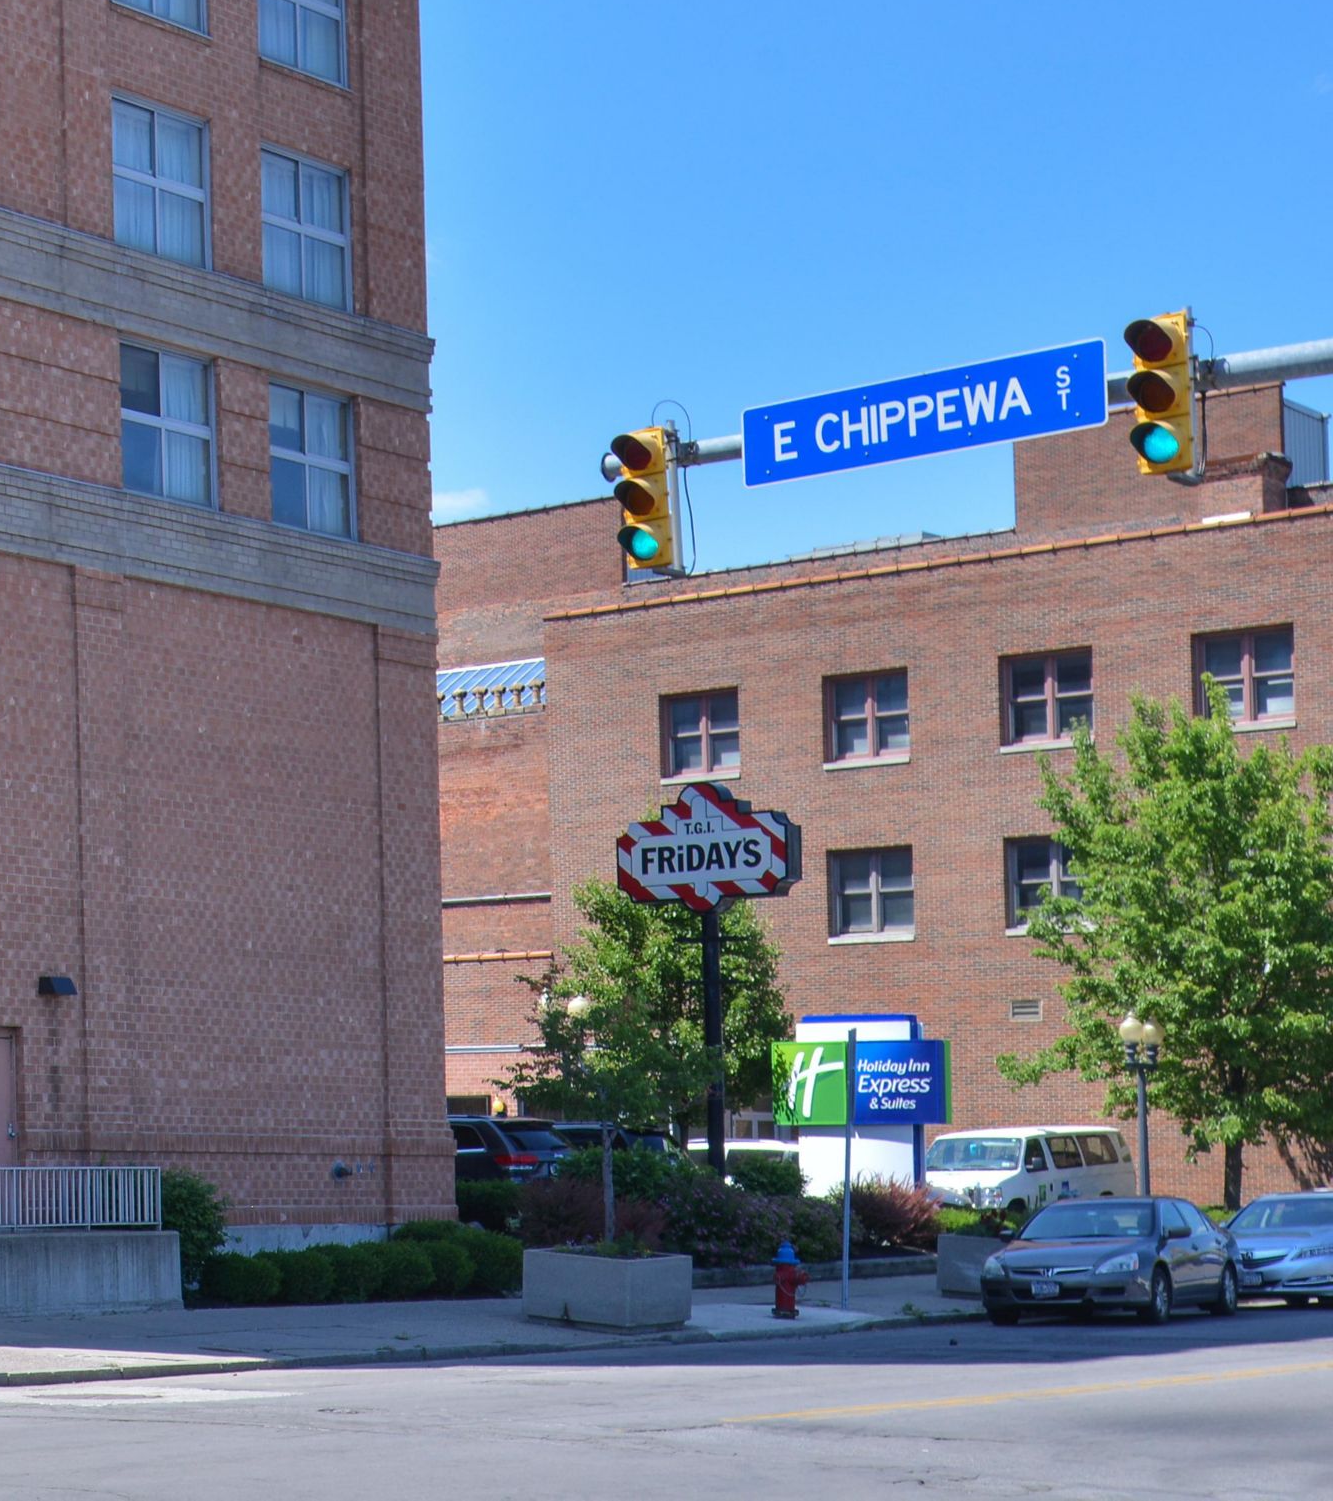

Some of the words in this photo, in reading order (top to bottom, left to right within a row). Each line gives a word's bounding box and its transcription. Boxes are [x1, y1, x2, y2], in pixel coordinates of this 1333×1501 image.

[773, 420, 799, 462] E
[814, 376, 1033, 454] CHIPPEWA
[1055, 365, 1072, 412] ST
[684, 821, 716, 835] T.G.I.
[857, 1059, 909, 1075] Holiday
[908, 1058, 931, 1073] Inn
[857, 1074, 931, 1097] Express
[869, 1097, 879, 1110] &
[880, 1097, 917, 1110] Suites
